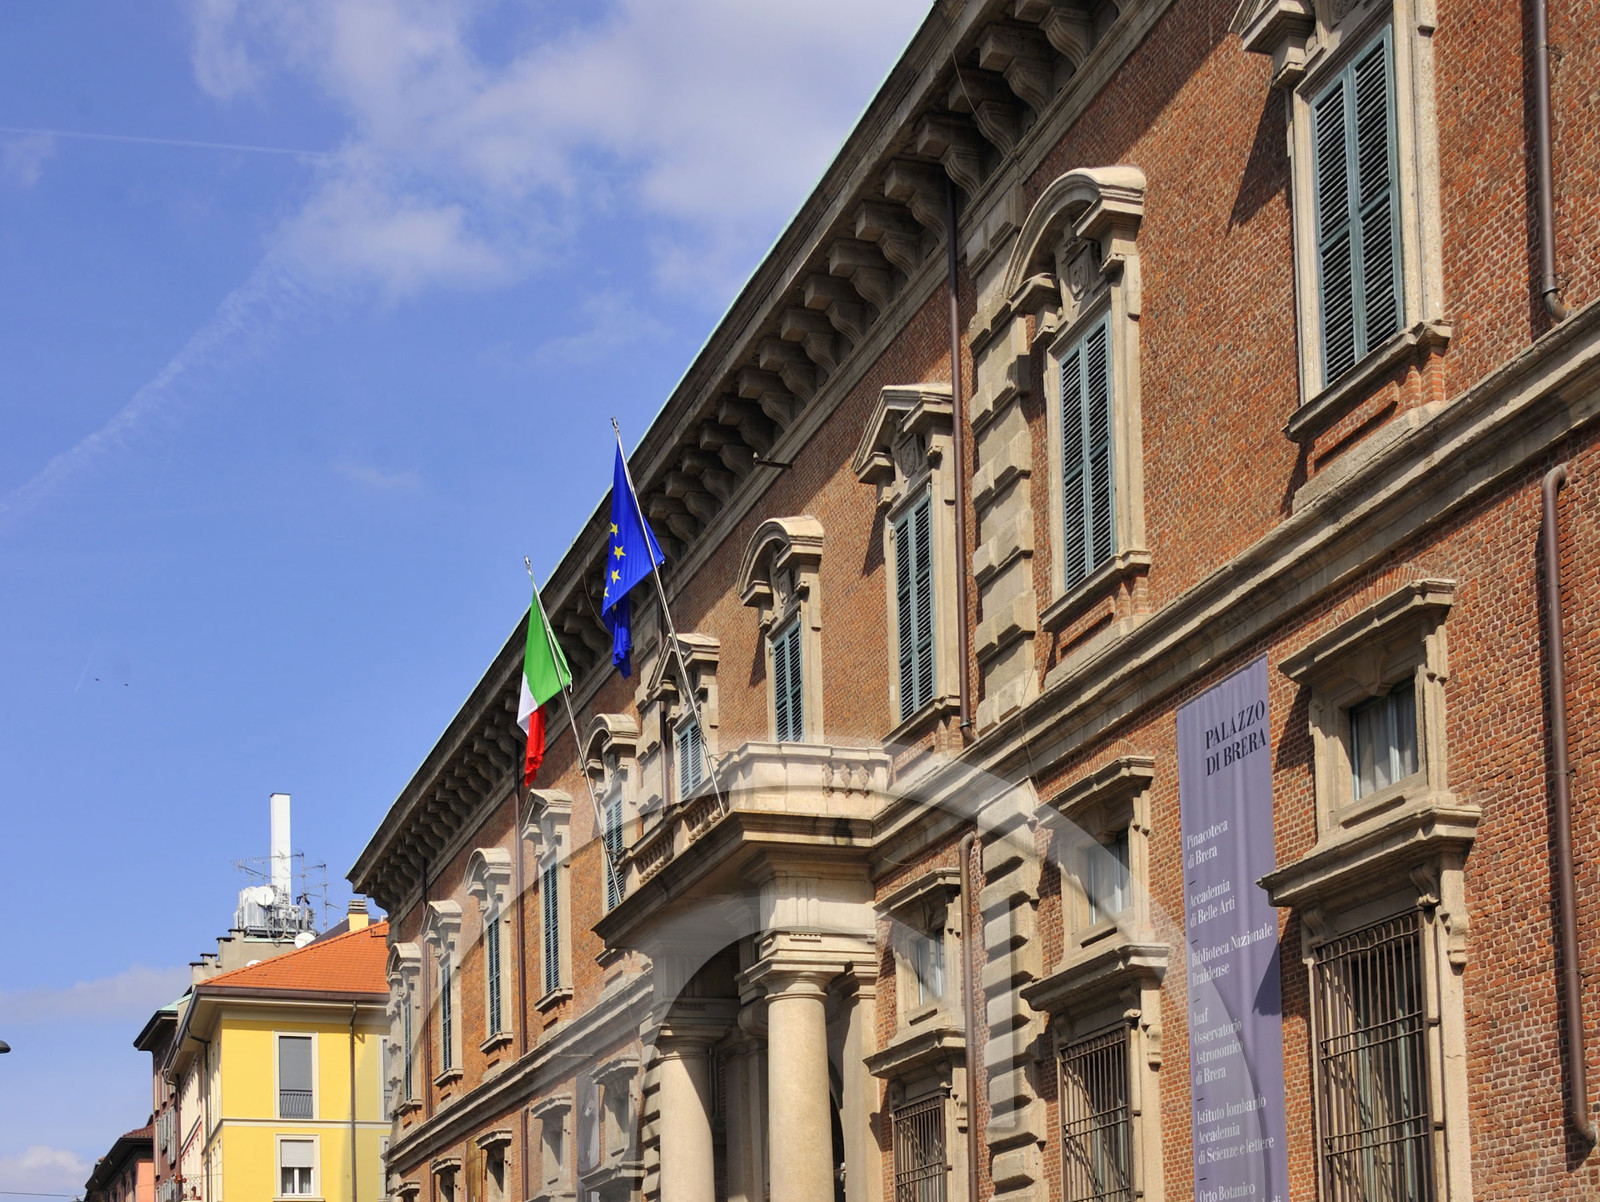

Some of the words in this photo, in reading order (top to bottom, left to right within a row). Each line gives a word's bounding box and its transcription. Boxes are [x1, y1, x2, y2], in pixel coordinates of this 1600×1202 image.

[1205, 700, 1265, 750] PALAZZO
[1206, 752, 1220, 776] DI
[1223, 728, 1267, 767] BRERA
[1186, 820, 1228, 850] Pinacoteca
[1187, 854, 1195, 870] di
[1195, 846, 1218, 866] Brera
[1189, 879, 1230, 909] Accademia
[1190, 911, 1197, 928] di
[1197, 904, 1218, 924] Belle
[1220, 895, 1235, 915] Arti
[1191, 942, 1229, 968] Biblioteca
[1230, 923, 1273, 951] Nazionale
[1192, 963, 1230, 987] Braidense
[1194, 1018, 1242, 1046] Osservatorio
[1195, 1040, 1244, 1066] Astronomico
[1195, 1070, 1203, 1086] di
[1203, 1067, 1226, 1083] Brera
[1197, 1107, 1225, 1125] Istituto
[1198, 1122, 1241, 1145] Accademia
[1198, 1152, 1206, 1165] di
[1206, 1146, 1238, 1163] Scienze
[1239, 1144, 1245, 1154] e
[1245, 1136, 1275, 1153] lettere
[1218, 1182, 1256, 1200] Botanico
